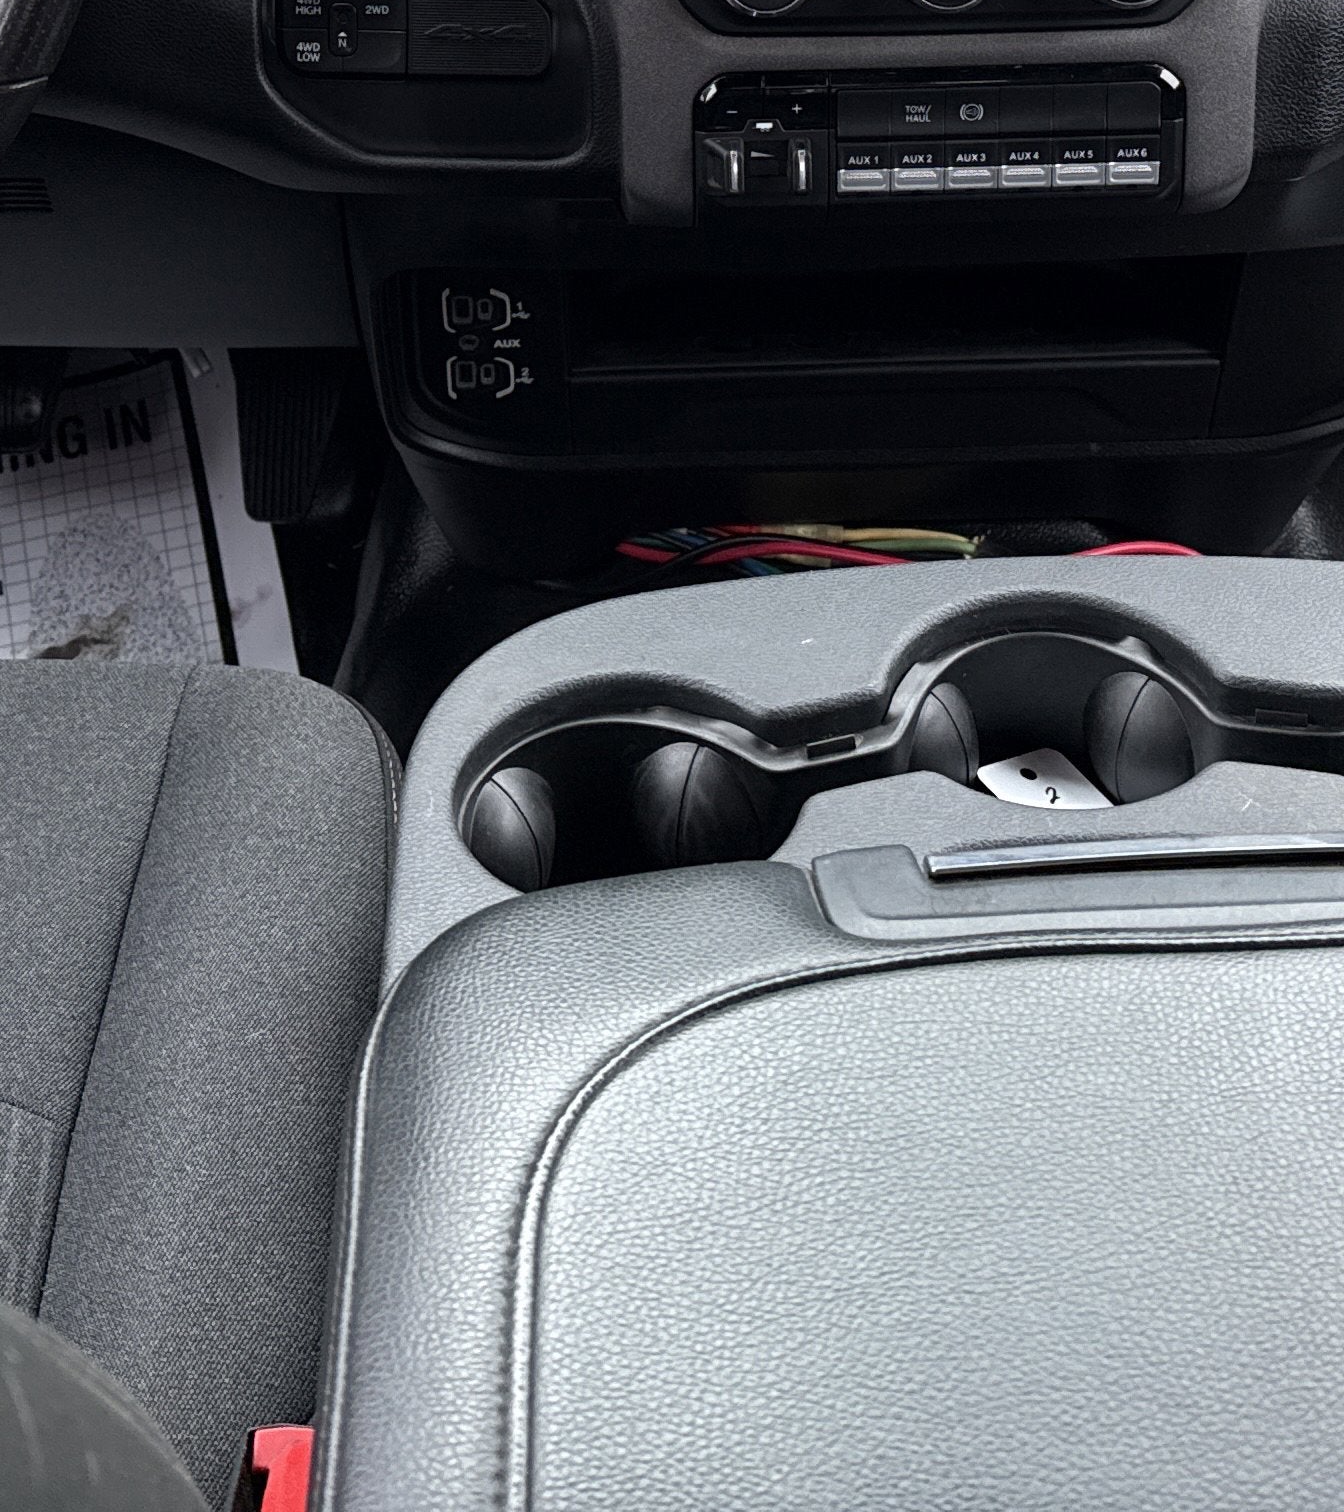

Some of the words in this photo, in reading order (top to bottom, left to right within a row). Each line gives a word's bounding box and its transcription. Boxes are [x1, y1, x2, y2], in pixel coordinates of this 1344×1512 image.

[295, 5, 322, 16] HIGH
[365, 5, 390, 15] 2WD
[296, 42, 321, 52] 4WD
[338, 38, 347, 48] N
[296, 52, 321, 63] LOW
[905, 113, 931, 123] HAUL
[956, 153, 977, 163] AUX
[1009, 152, 1030, 161] AUX
[1063, 150, 1085, 160] AUX
[1117, 149, 1138, 159] AUX
[848, 156, 870, 165] AUX
[902, 155, 922, 164] AUX
[493, 338, 521, 348] AUX
[103, 399, 153, 451] IN
